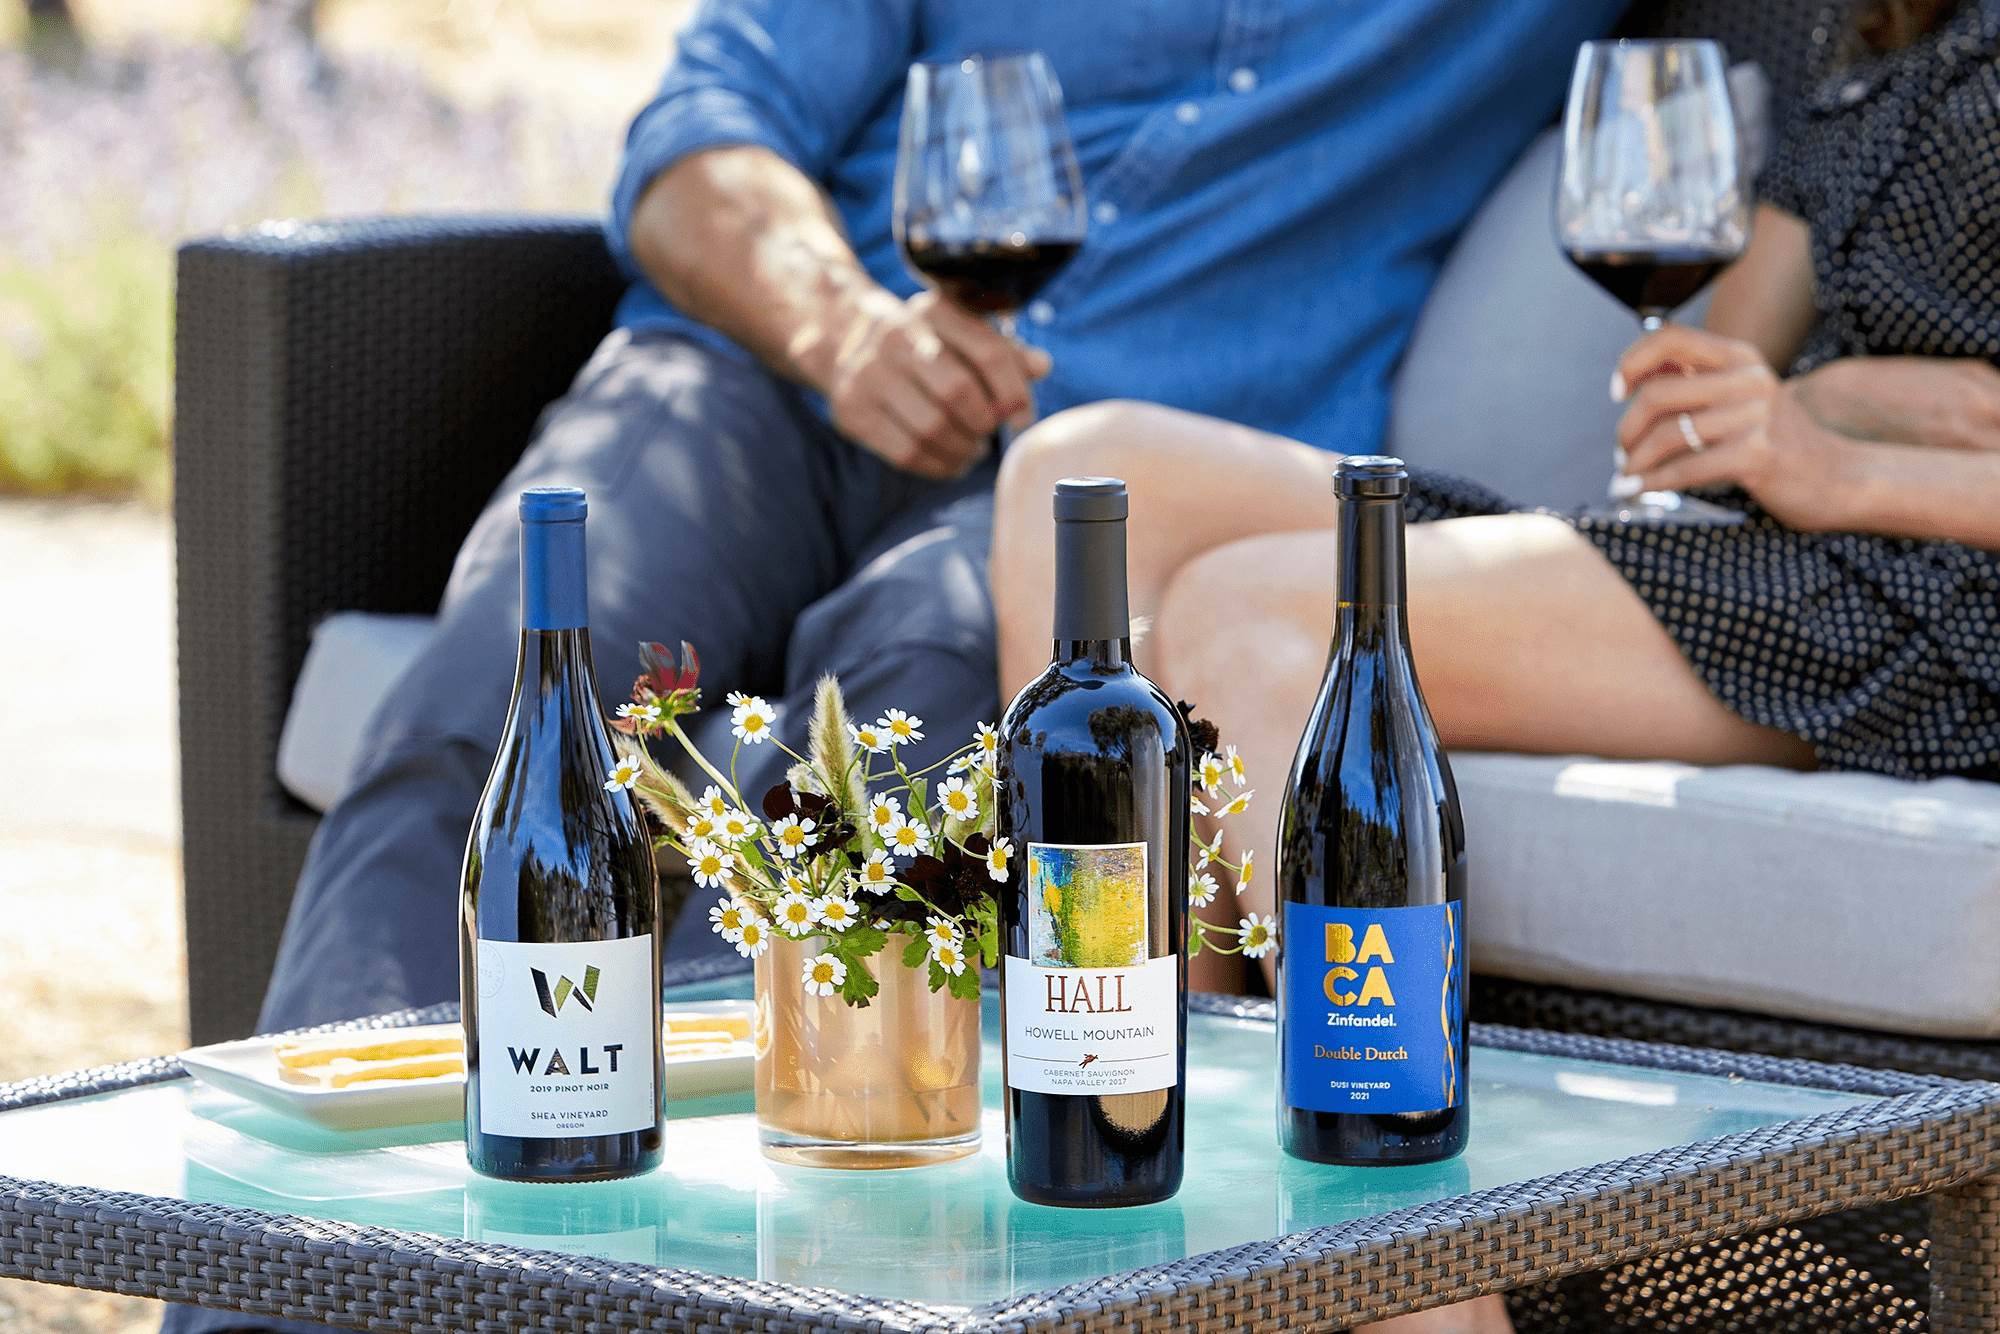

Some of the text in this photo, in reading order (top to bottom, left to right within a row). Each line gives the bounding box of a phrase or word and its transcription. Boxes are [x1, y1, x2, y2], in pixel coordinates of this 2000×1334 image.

[1325, 922, 1395, 964] BA
[1044, 974, 1132, 1014] HALL
[1323, 966, 1396, 1007] CA
[1327, 1012, 1397, 1027] Zinfandel.
[1025, 1026, 1154, 1041] HOWELL MOUNTAIN
[507, 1043, 623, 1075] WALT
[1314, 1045, 1408, 1061] Double Dutch
[1043, 1068, 1135, 1078] CABERNET SAUVIGNON
[530, 1083, 610, 1093] 2019 PINOT NOIR
[1051, 1077, 1127, 1087] NAPA VALLEY 2017
[1330, 1080, 1391, 1090] DUSI VINEYARD
[1350, 1091, 1369, 1100] 2021
[531, 1109, 609, 1120] SHEA VINEYARD
